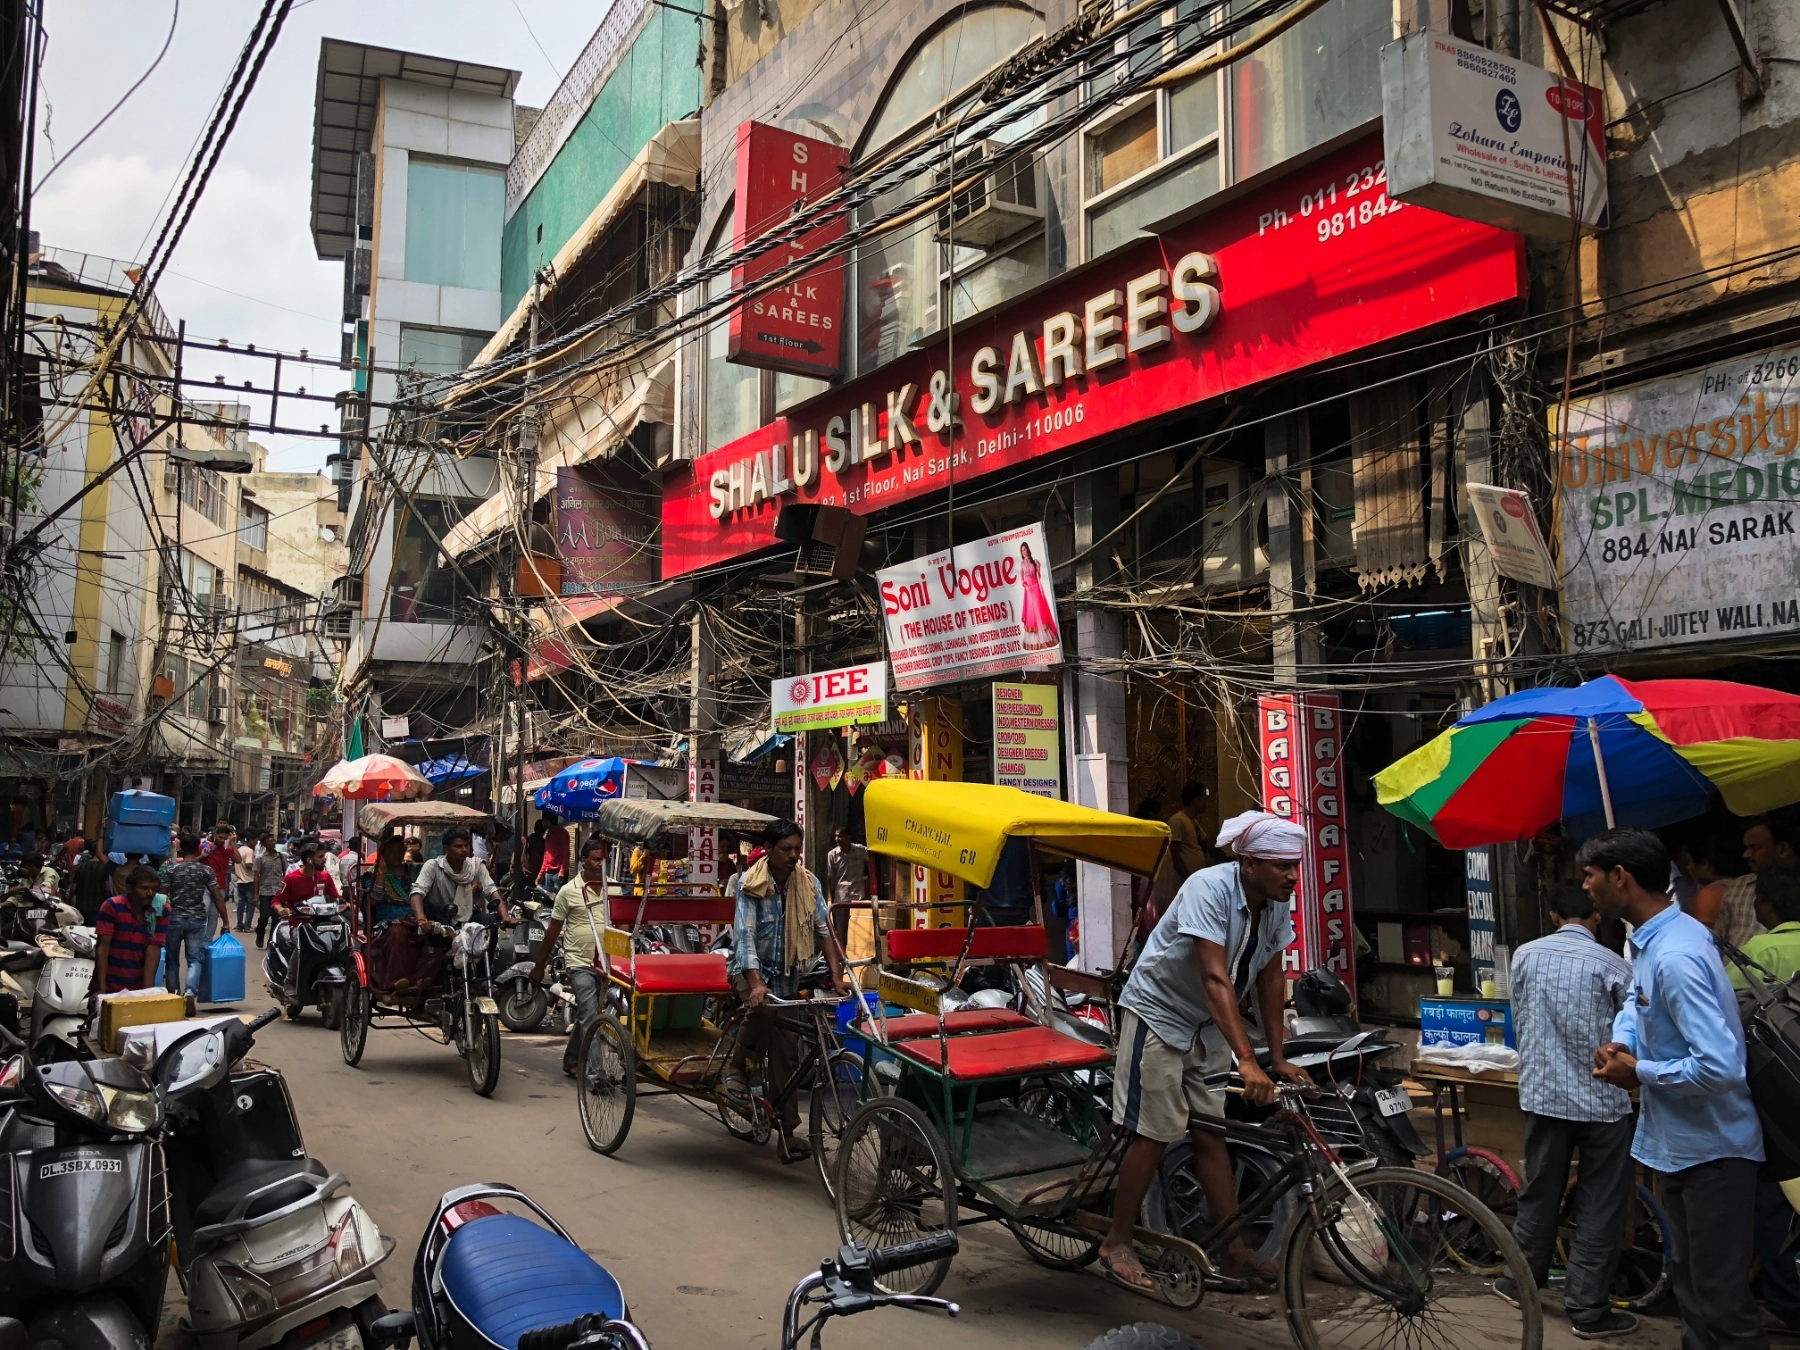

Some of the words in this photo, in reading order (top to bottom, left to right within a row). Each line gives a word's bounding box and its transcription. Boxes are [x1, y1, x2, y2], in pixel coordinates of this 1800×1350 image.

[1457, 49, 1516, 76] 8860828502
[1457, 58, 1516, 85] 8860827460
[1448, 121, 1506, 152] Zohara
[1456, 143, 1498, 163] Wholesale
[1500, 156, 1507, 165] of
[1514, 160, 1533, 173] Suits
[1543, 168, 1578, 186] Lehangs
[1471, 176, 1482, 187] NO
[1485, 180, 1508, 194] Return
[1510, 187, 1521, 197] No
[1522, 190, 1556, 207] Exchange
[1259, 209, 1294, 237] Ph.
[1300, 183, 1337, 217] 011
[1317, 193, 1411, 243] 981842
[774, 282, 817, 301] ILK
[790, 297, 804, 309] &
[753, 301, 833, 330] SAREES
[763, 333, 777, 345] 1st
[709, 429, 818, 519] SHALU
[825, 383, 922, 474] SILK
[927, 369, 963, 433] &
[970, 252, 1221, 415] SAREES
[843, 487, 861, 505] 1st
[863, 475, 899, 499] Floor,
[903, 464, 924, 485] Nai
[928, 447, 973, 475] Sarak,
[977, 403, 1085, 459] Delhi-110006
[1558, 391, 1800, 490] University
[560, 519, 592, 550] AA
[1660, 527, 1696, 554] NAI
[1709, 511, 1795, 546] SARAK
[881, 573, 931, 616] Soni
[938, 556, 1017, 602] Vogue
[904, 620, 922, 640] THE
[923, 613, 953, 637] HOUSE
[955, 611, 967, 629] OF
[968, 604, 1008, 627] TRENDS
[812, 668, 868, 704] JEE
[996, 688, 1022, 699] DESIGNER
[997, 702, 1007, 714] ONE
[1008, 703, 1022, 714] PIECE
[1024, 703, 1042, 715] GOWNS
[997, 717, 1009, 728] INDO
[1010, 717, 1034, 729] WESTERN
[1034, 718, 1057, 730] DRESSES
[913, 711, 924, 780] SON
[997, 732, 1010, 742] CROP
[1011, 732, 1025, 744] TOPS
[998, 747, 1023, 759] DESIGNER
[1024, 748, 1047, 760] DRESSES
[997, 763, 1025, 775] LEHANGAS
[1266, 708, 1292, 819] BAGG
[1313, 708, 1340, 849] BAGGA
[1000, 777, 1021, 787] FANCY
[1023, 778, 1057, 787] DESIGNER
[699, 827, 714, 874] HAND
[1467, 851, 1490, 882] COMM
[1468, 890, 1496, 922] ERCIAL
[1471, 929, 1495, 962] BANK
[1423, 1004, 1444, 1022] रबड़ी
[1446, 1007, 1475, 1024] फालूदा
[1424, 1026, 1449, 1044] कुल्फी
[41, 1160, 121, 1178] DL.3SBX.0931
